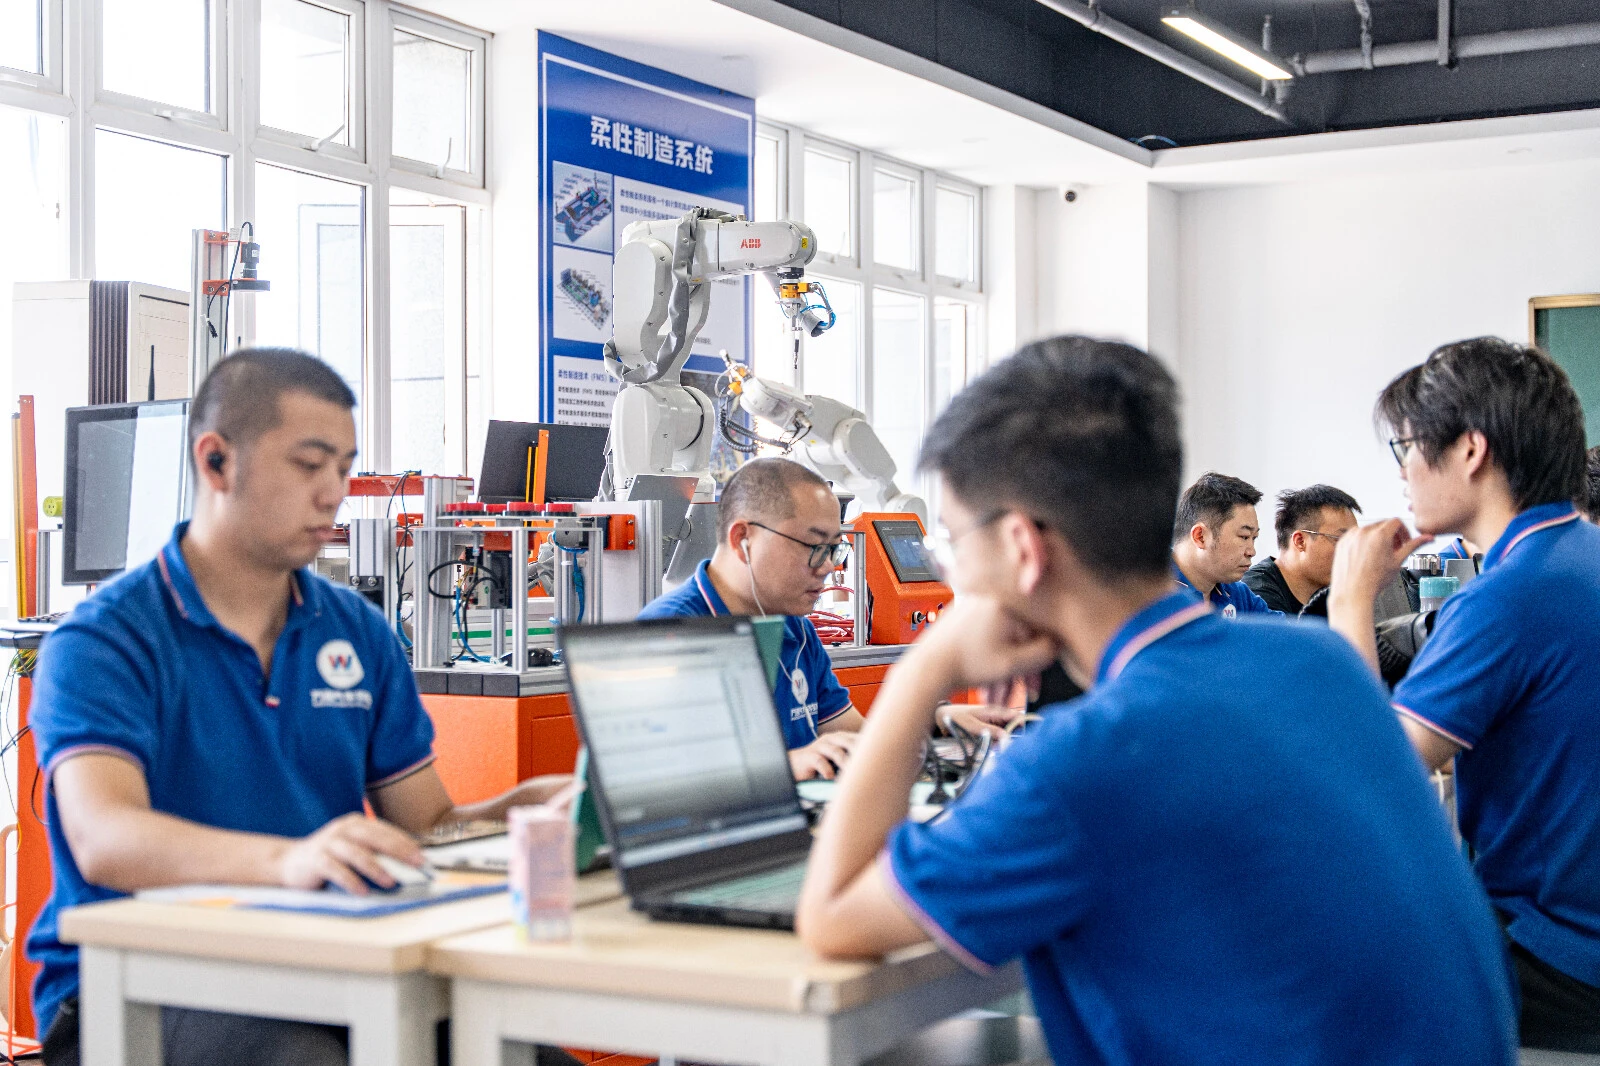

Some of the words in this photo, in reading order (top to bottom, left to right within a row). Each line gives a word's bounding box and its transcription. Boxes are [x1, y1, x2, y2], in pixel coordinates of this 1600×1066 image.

[590, 115, 713, 175] 柔性制造系统
[740, 239, 761, 249] ABB
[328, 654, 352, 671] W
